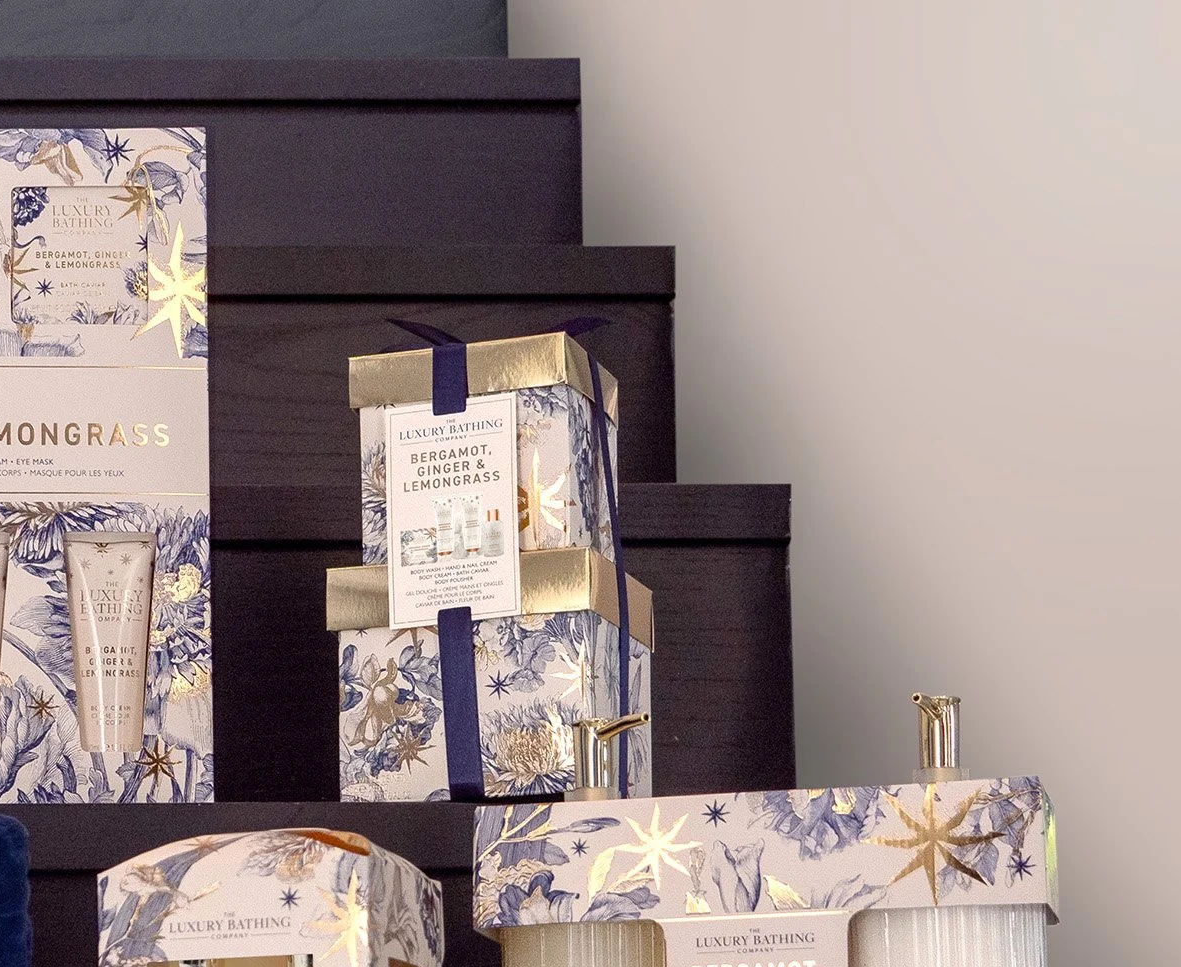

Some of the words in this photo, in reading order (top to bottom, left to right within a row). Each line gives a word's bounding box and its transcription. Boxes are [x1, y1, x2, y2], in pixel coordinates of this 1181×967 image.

[52, 205, 112, 216] LUXURY
[52, 218, 114, 229] BATHING
[35, 251, 91, 259] BERGAMOT,
[44, 261, 51, 269] &
[55, 261, 121, 269] LEMONGRASS
[399, 425, 445, 441] LUXURY
[449, 418, 504, 435] BATHING
[434, 435, 468, 443] COMPANY
[410, 444, 493, 465] BERGAMOT,
[29, 470, 62, 478] MASQUE
[417, 460, 471, 477] GINGER
[476, 459, 486, 470] &
[403, 471, 501, 492] LEMONGRASS
[169, 921, 223, 933] LUXURY
[227, 917, 292, 930] BATHING
[696, 936, 747, 948] LUXURY
[753, 933, 816, 945] BATHING
